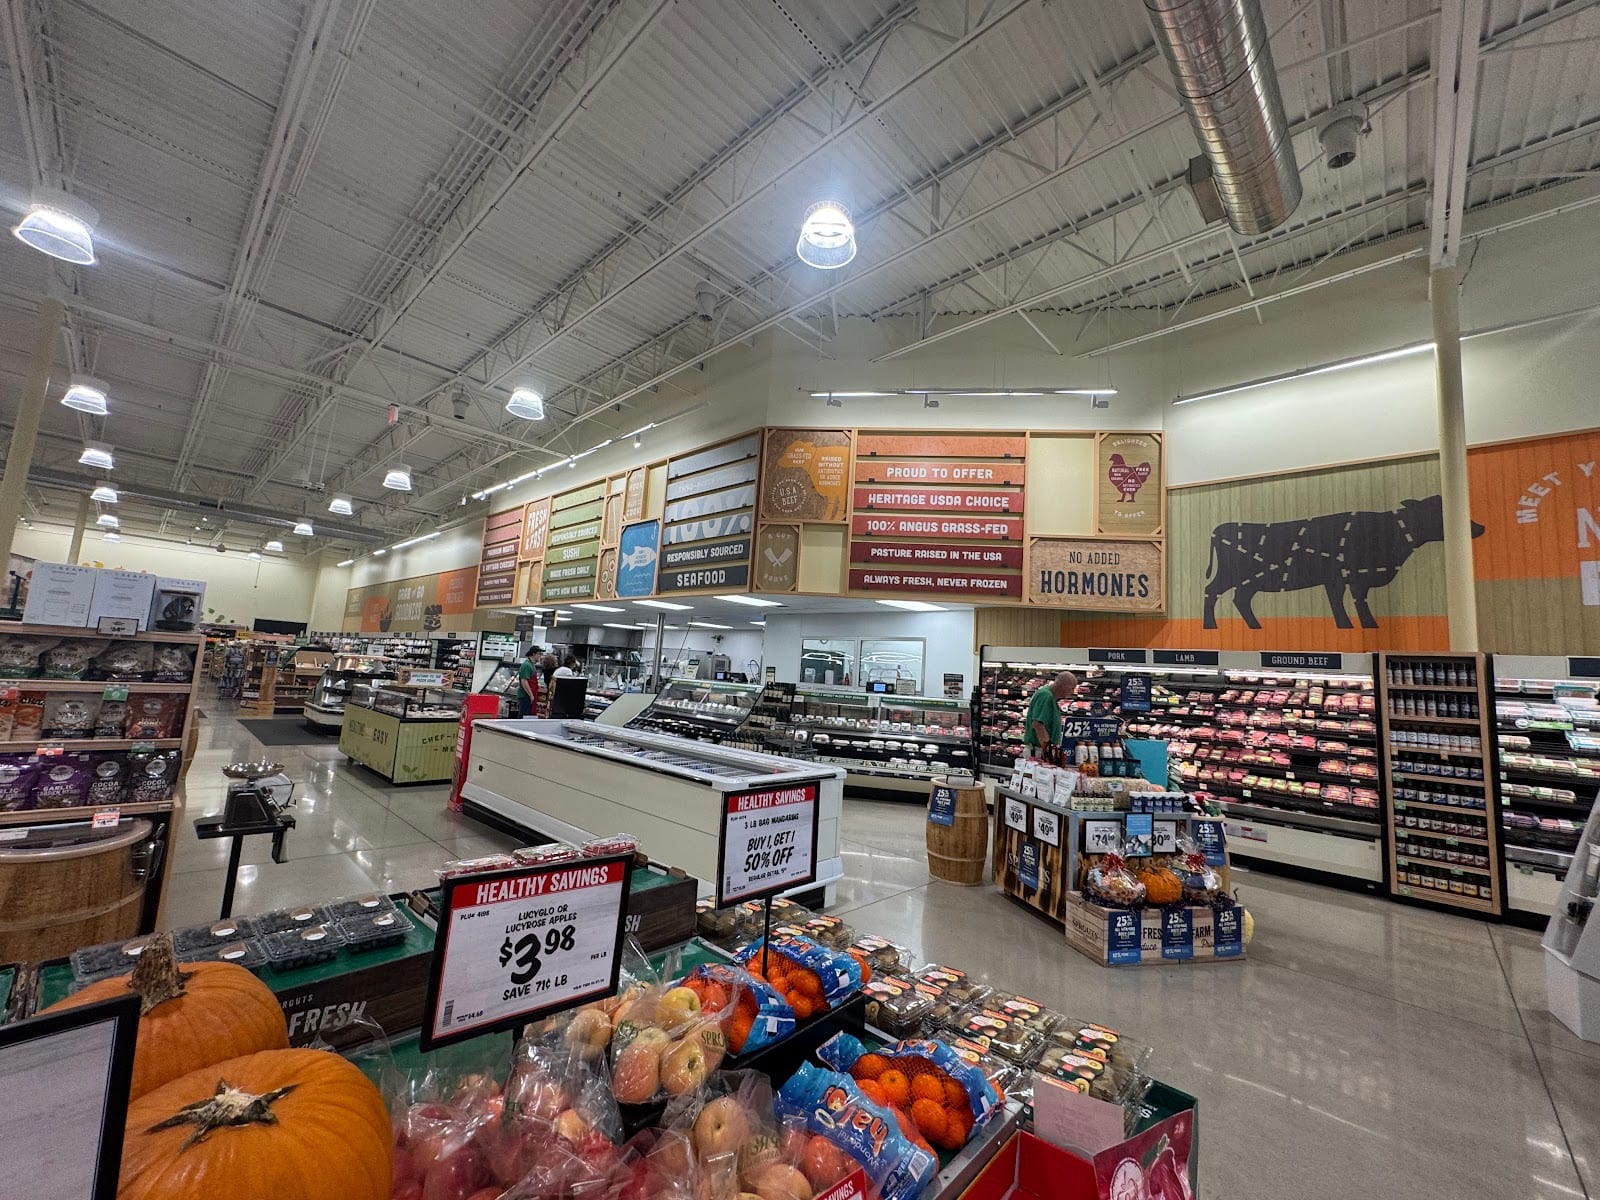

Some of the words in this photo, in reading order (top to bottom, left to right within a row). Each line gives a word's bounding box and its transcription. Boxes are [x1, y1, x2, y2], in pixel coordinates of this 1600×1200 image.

[887, 467, 927, 479] PROUD
[932, 468, 948, 479] TO
[952, 468, 993, 479] OFFER
[781, 496, 798, 506] BEEF
[868, 493, 926, 505] HERITAGE
[930, 495, 962, 506] USDA
[965, 496, 1009, 508] CHOICE
[1516, 471, 1562, 524] MEET
[526, 508, 548, 536] FRESH
[867, 520, 896, 532] 100%
[899, 521, 939, 533] ANGUS
[941, 522, 1009, 535] GRASS-FED
[562, 547, 580, 560] SUSHI
[667, 548, 709, 563] RESPONSIBLY
[710, 544, 744, 557] SOURCED
[871, 548, 913, 558] PASTURE
[914, 549, 947, 559] RAISED
[950, 551, 960, 560] IN
[962, 551, 981, 561] THE
[983, 552, 1002, 561] USA
[1069, 551, 1082, 564] NO
[1087, 552, 1120, 565] ADDED
[676, 569, 726, 587] SEAFOOD
[864, 574, 901, 585] ALWAYS
[902, 576, 935, 587] FRESH,
[937, 577, 968, 588] NEVER
[970, 578, 1008, 589] FROZEN
[1040, 570, 1149, 598] HORMONES
[579, 583, 591, 593] ROLL
[1108, 652, 1126, 661] PORK
[1175, 653, 1195, 662] LAMB
[1271, 656, 1305, 666] GROUND
[1308, 656, 1329, 666] BEEF
[1128, 678, 1143, 686] 25%
[373, 728, 389, 745] EASY
[1064, 721, 1091, 737] 25%
[43, 783, 75, 791] GARLIC
[92, 780, 119, 788] COCOA
[737, 792, 774, 811] HEALTHY
[774, 788, 806, 805] SAVINGS
[750, 820, 757, 829] LB
[758, 818, 770, 827] BAG
[1198, 823, 1214, 834] 25%
[747, 835, 767, 852] BUY
[767, 834, 772, 850] 1,
[774, 830, 792, 846] GET
[791, 830, 796, 842] 1
[743, 851, 771, 873] 50%
[772, 846, 795, 867] OFF
[476, 874, 548, 905] HEALTHY
[549, 866, 608, 892] SAVINGS
[518, 907, 554, 921] LUCYGLO
[557, 904, 568, 914] OR
[1219, 910, 1234, 922] 25%
[505, 919, 547, 934] LUCYROSE
[549, 912, 578, 925] APPLES
[1116, 915, 1132, 927] 25%
[1072, 919, 1098, 940] SPROUTS
[600, 951, 607, 959] LB
[502, 984, 531, 1001] SAVE
[535, 978, 551, 993] 71¢
[554, 974, 568, 988] LB
[282, 993, 314, 1009] ROUTS
[288, 1000, 367, 1038] FRESH
[837, 1130, 879, 1167] Wonderful
